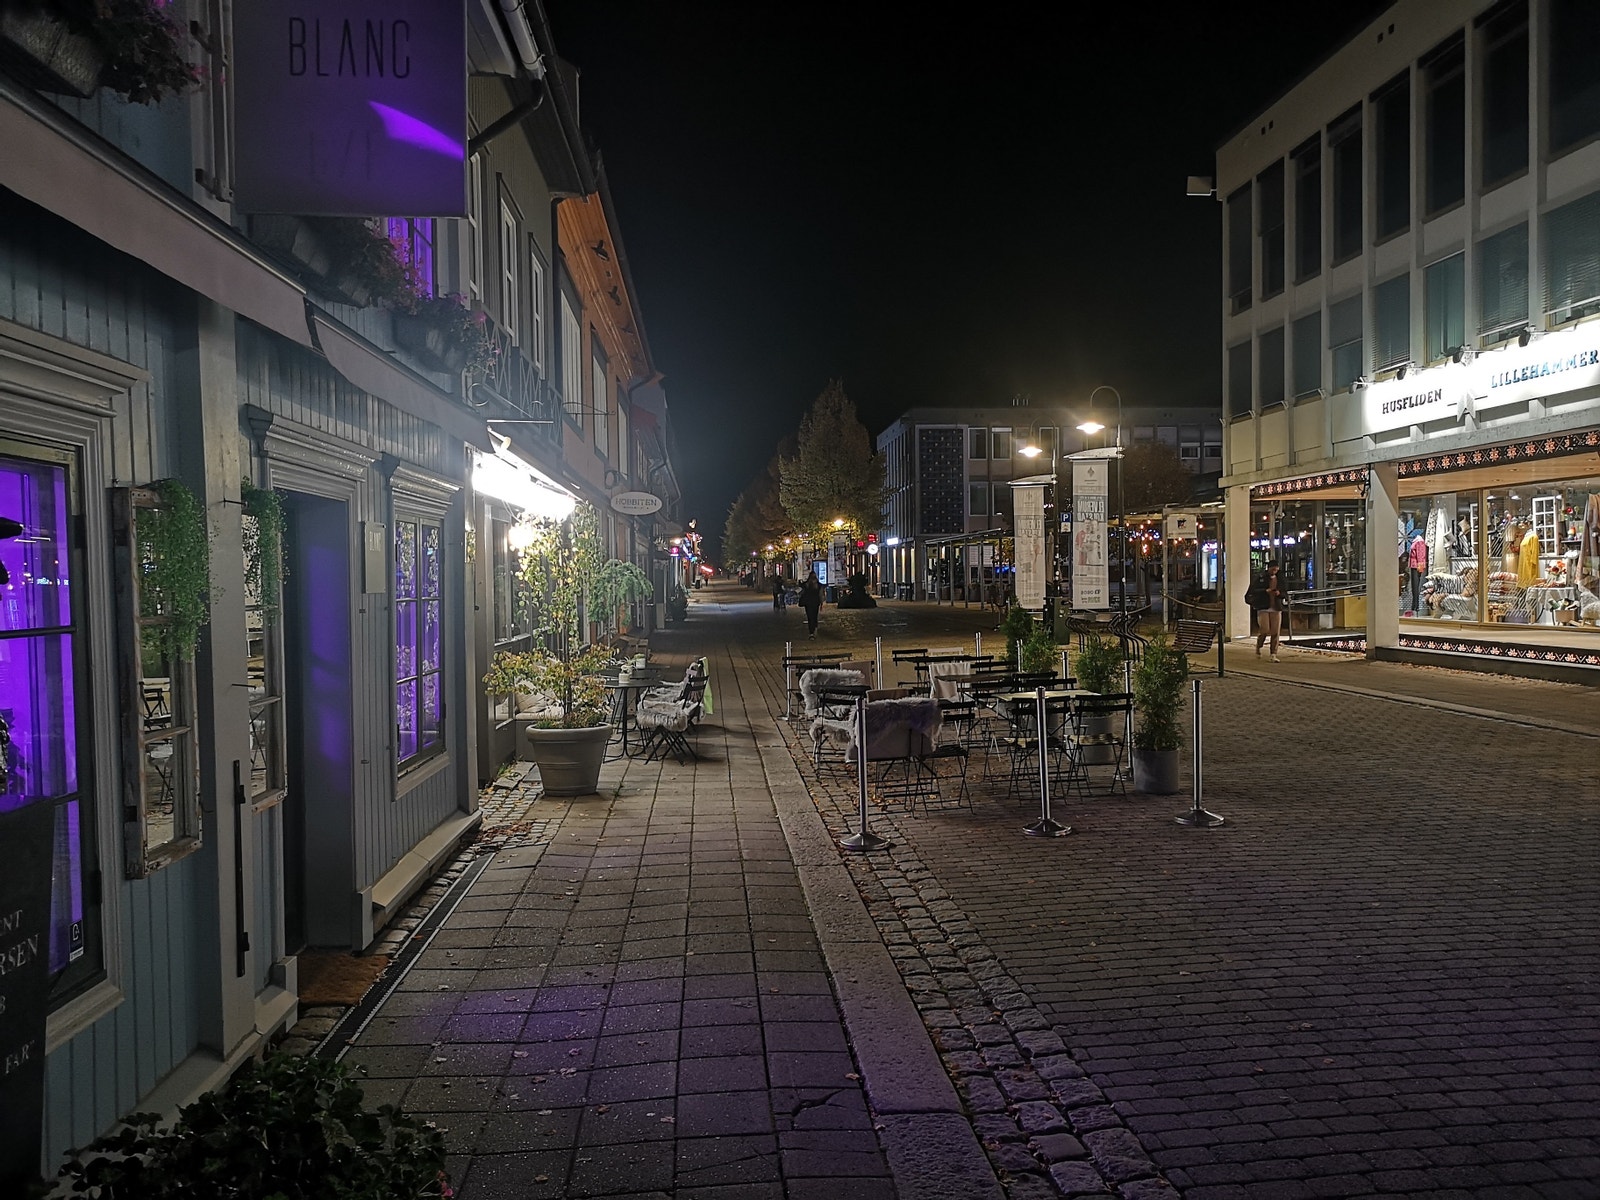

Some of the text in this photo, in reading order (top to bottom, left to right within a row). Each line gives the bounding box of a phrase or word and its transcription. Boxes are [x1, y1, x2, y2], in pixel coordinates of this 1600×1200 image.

[288, 16, 411, 79] BLANC
[1381, 348, 1600, 415] HUSFLIDEN LILLEHAMMER
[615, 497, 657, 508] HOBBITEN
